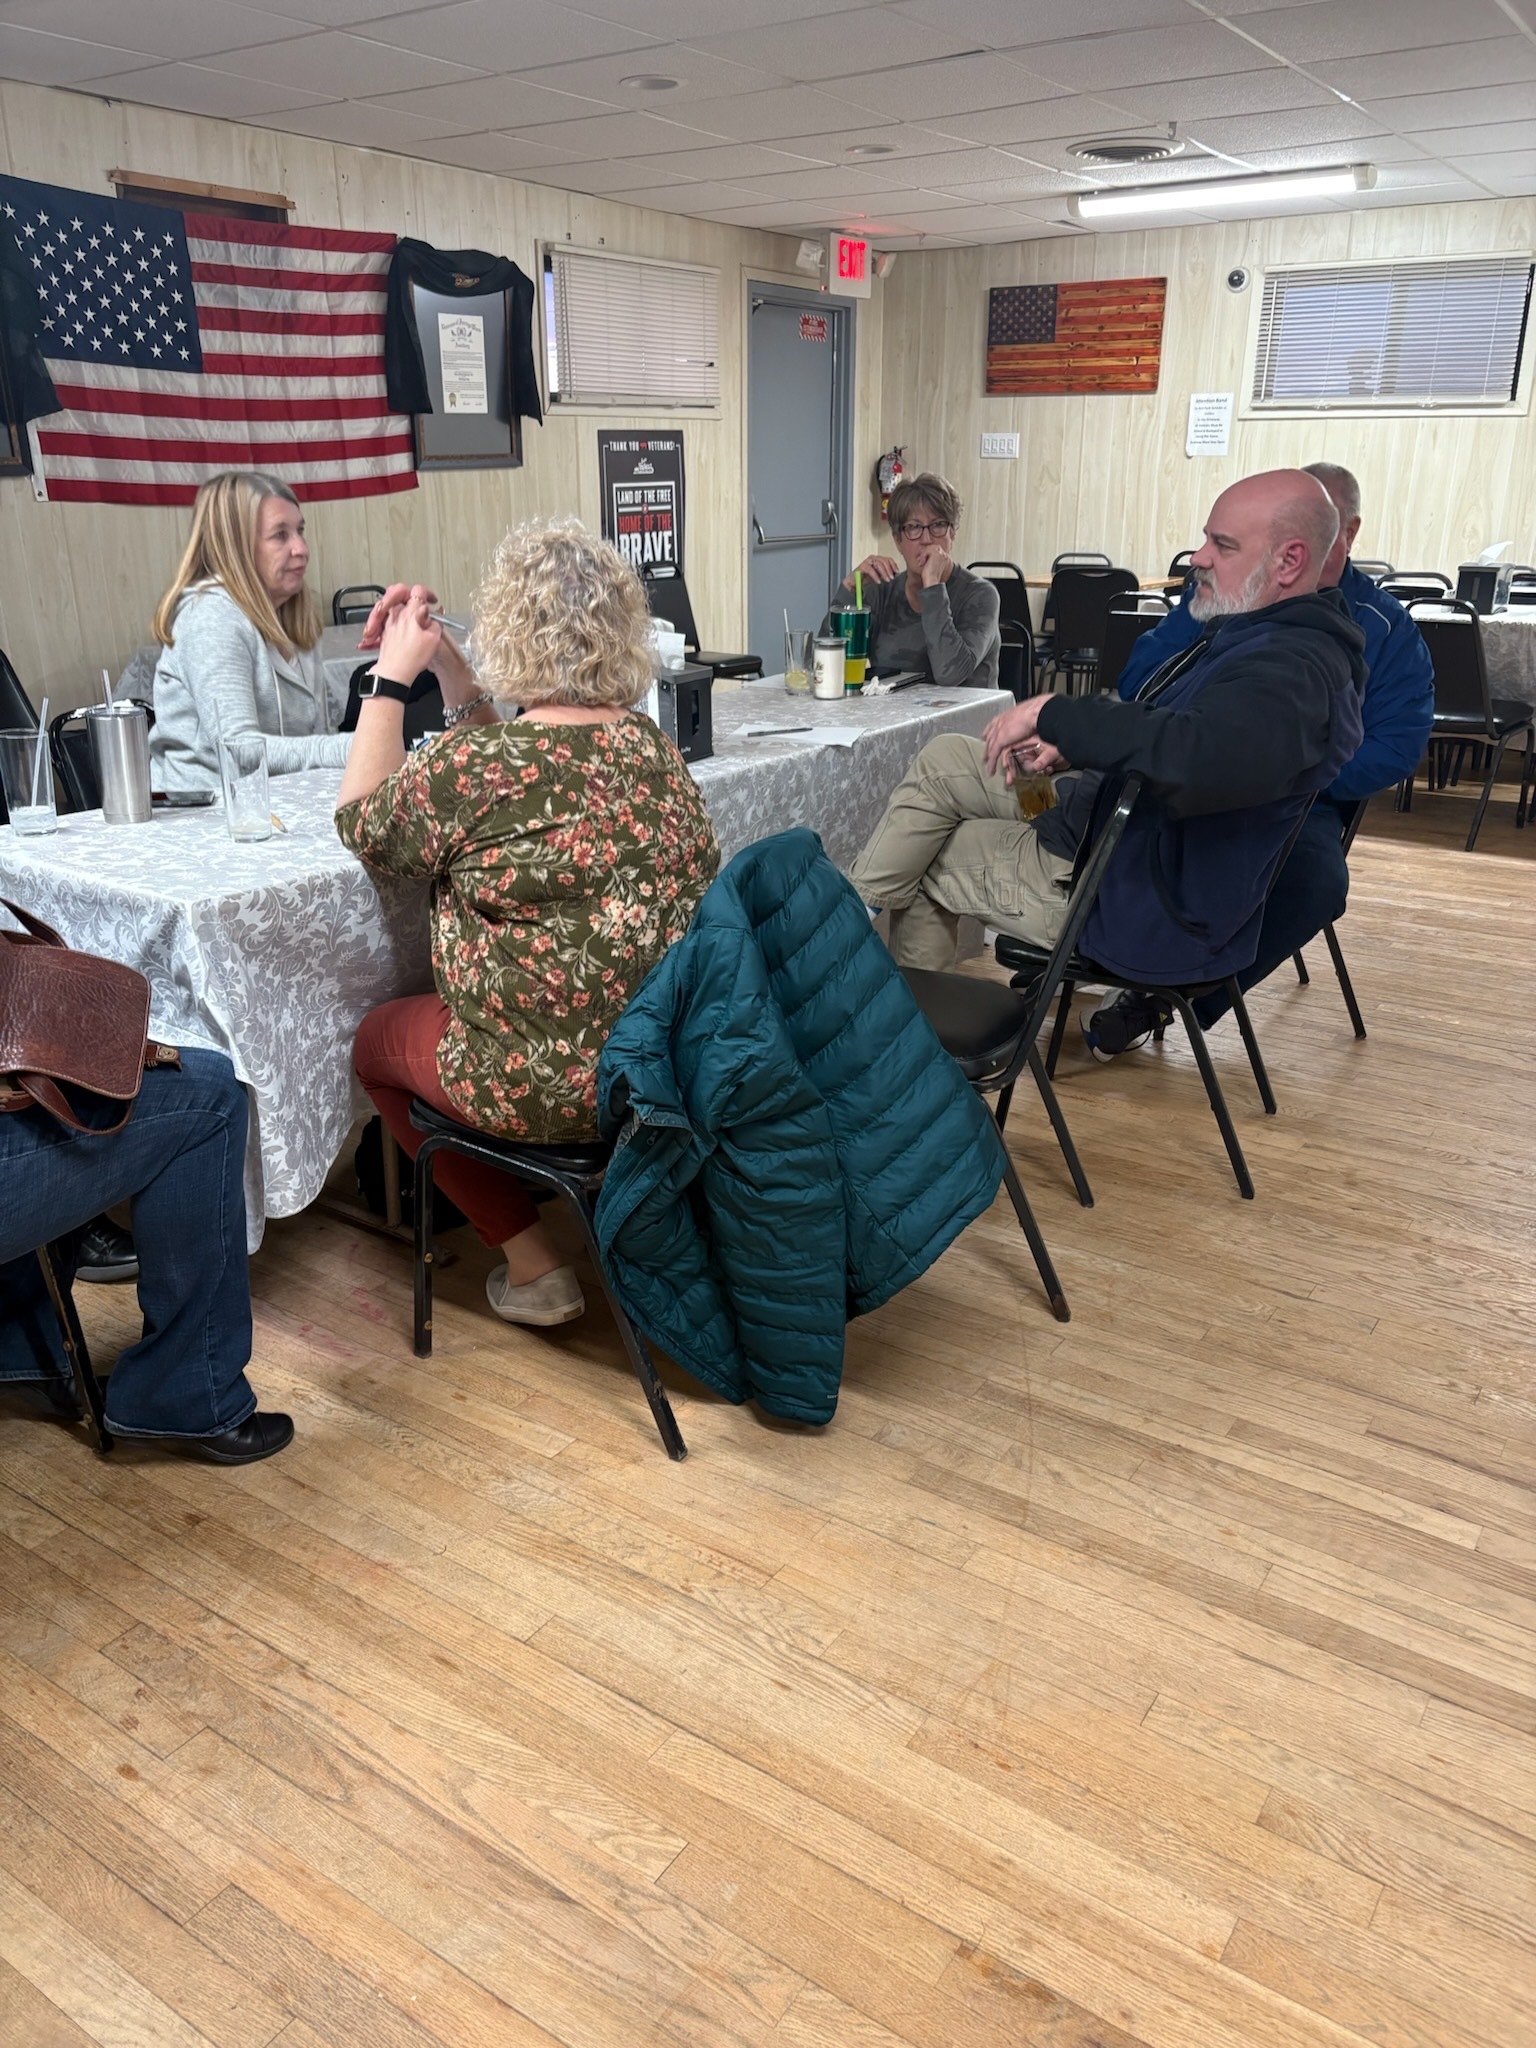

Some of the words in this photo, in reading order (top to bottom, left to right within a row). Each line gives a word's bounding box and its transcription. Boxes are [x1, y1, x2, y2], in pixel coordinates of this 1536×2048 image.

[838, 238, 866, 281] EXIT
[609, 440, 628, 452] THANK
[628, 440, 640, 452] YOU
[647, 440, 676, 452] VETERANS!
[617, 490, 634, 505] LAND
[634, 490, 642, 504] OF
[643, 489, 656, 503] THE
[656, 488, 672, 503] FREE
[618, 515, 642, 533] HOME
[643, 514, 655, 532] OF
[656, 513, 672, 531] THE
[619, 530, 673, 567] BRAVE
